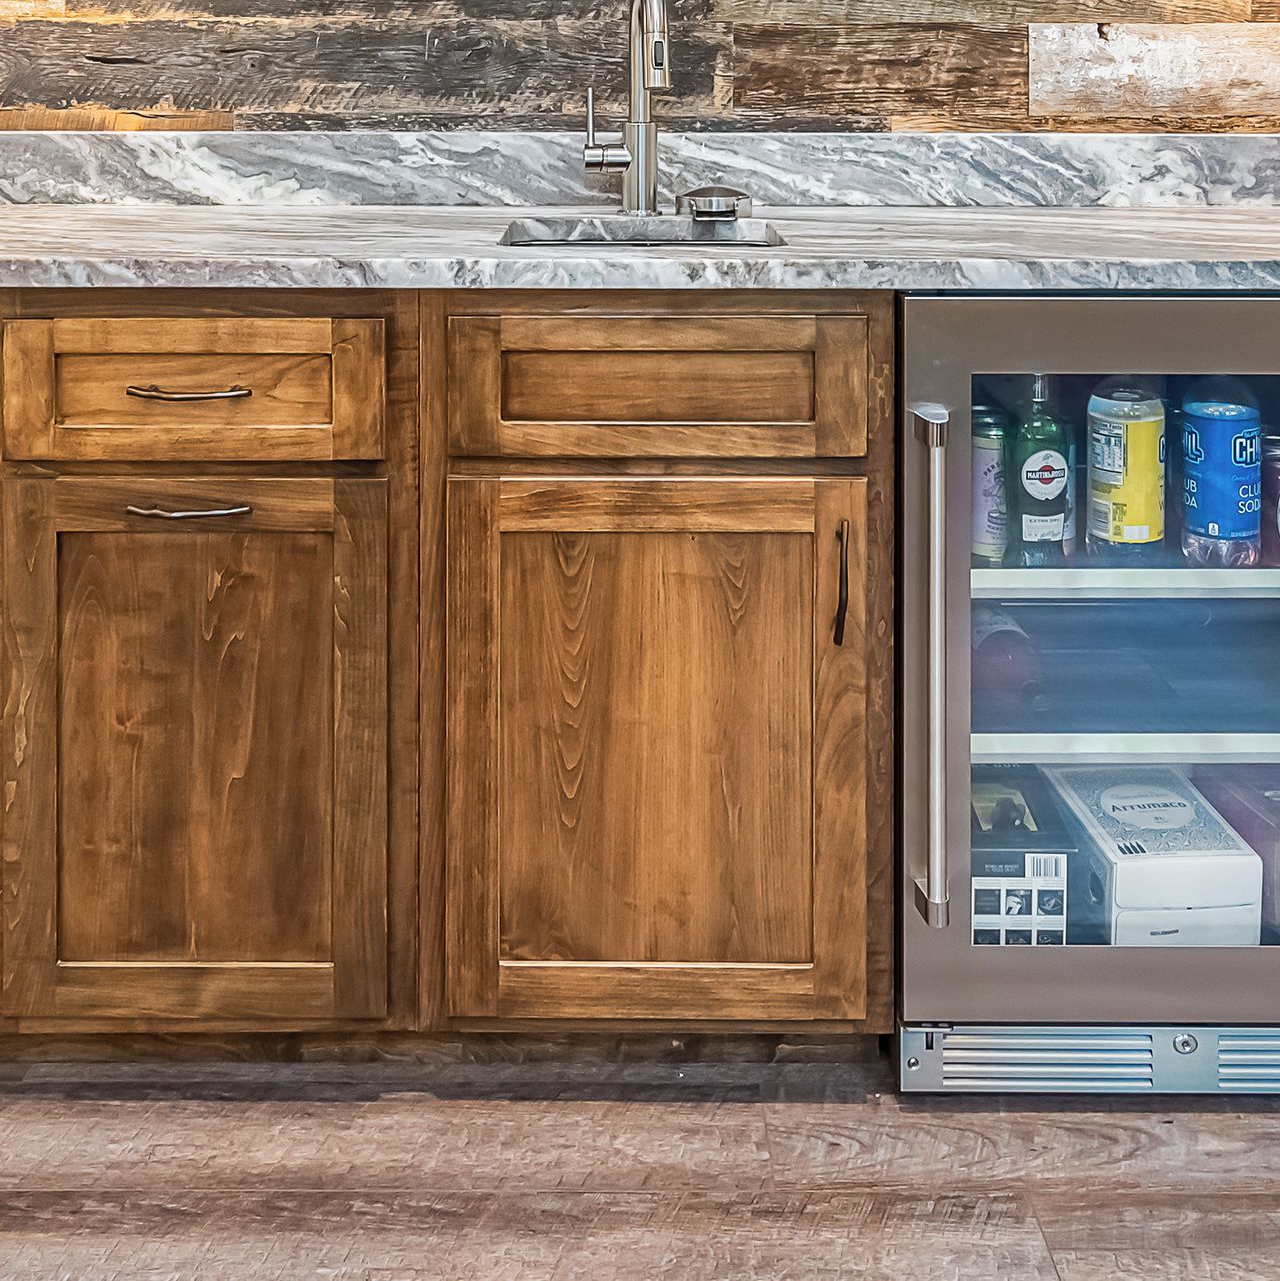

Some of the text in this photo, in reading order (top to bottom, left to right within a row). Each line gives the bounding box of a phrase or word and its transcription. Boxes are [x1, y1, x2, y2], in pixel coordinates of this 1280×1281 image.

[1239, 481, 1261, 498] CLU
[1238, 499, 1261, 514] SOD
[1111, 801, 1187, 813] Arrumaco
